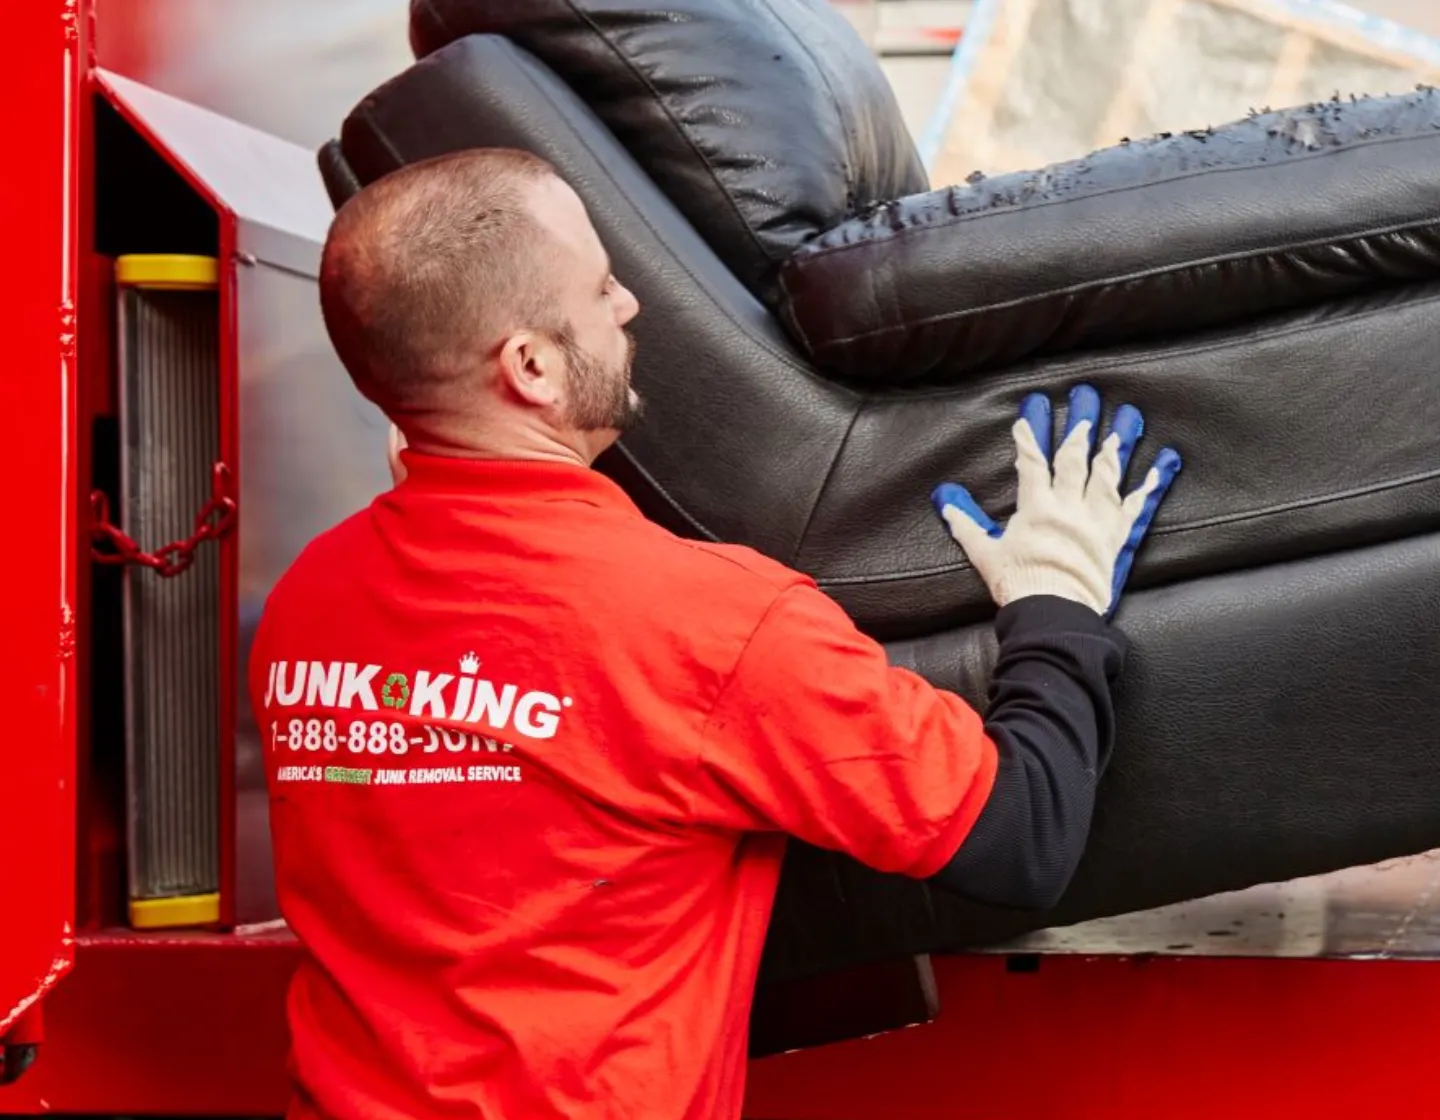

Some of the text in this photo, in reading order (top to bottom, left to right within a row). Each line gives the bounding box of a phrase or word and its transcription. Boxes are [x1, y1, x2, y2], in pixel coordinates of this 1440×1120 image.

[265, 660, 562, 739] JUNK KING
[271, 718, 513, 755] 1-888-888-JUN
[277, 766, 323, 781] AMERICA'S
[374, 769, 407, 784] JUNK
[408, 767, 465, 784] REMOVAL
[467, 766, 521, 781] SERVICE
